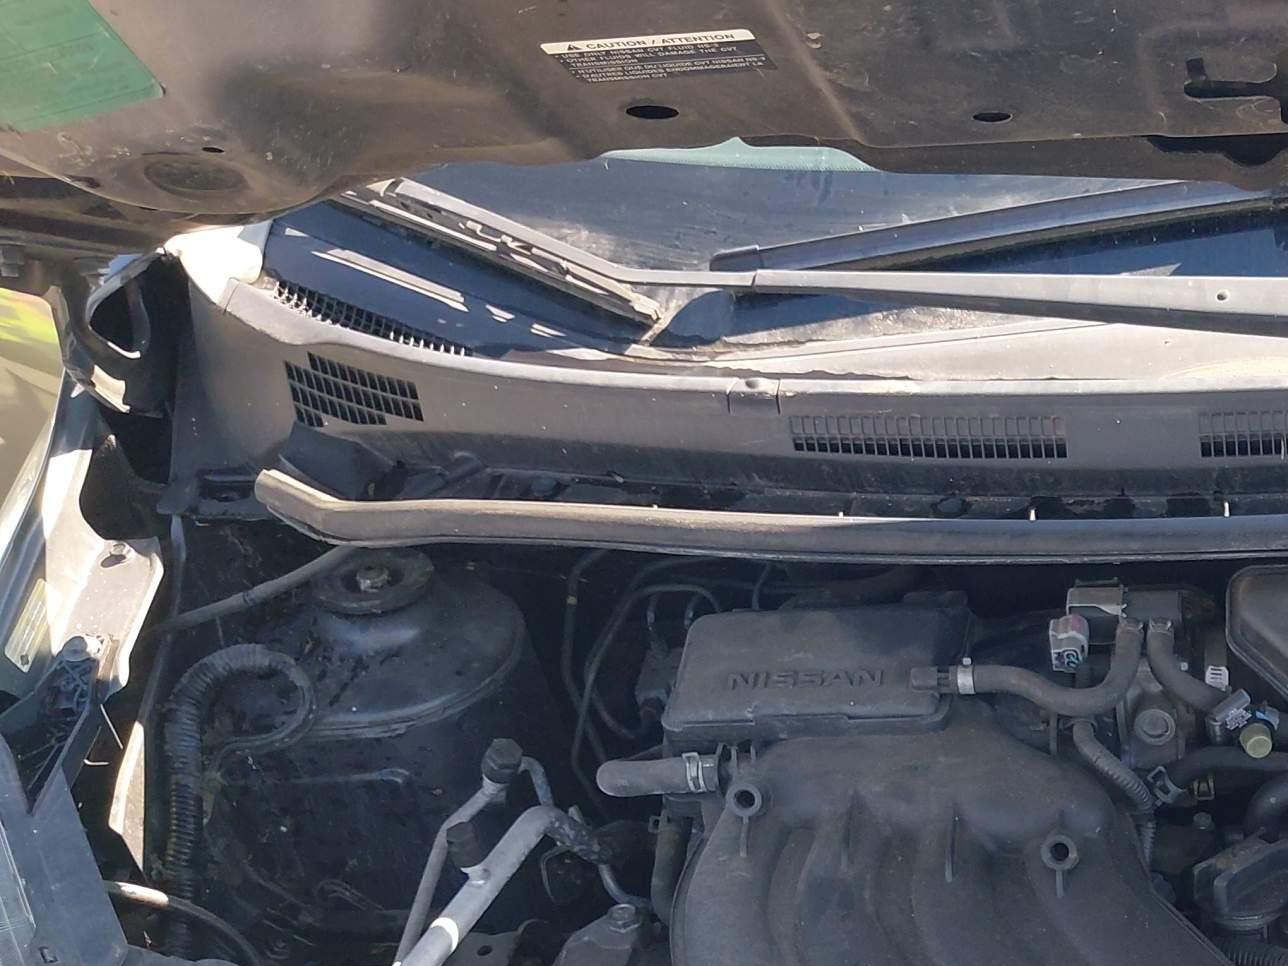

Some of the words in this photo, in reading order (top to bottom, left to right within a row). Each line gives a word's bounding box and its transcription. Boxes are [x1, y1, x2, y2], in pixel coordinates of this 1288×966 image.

[586, 40, 647, 49] CAUTION
[662, 33, 735, 44] ATTENTION
[728, 670, 884, 690] NISSAN
